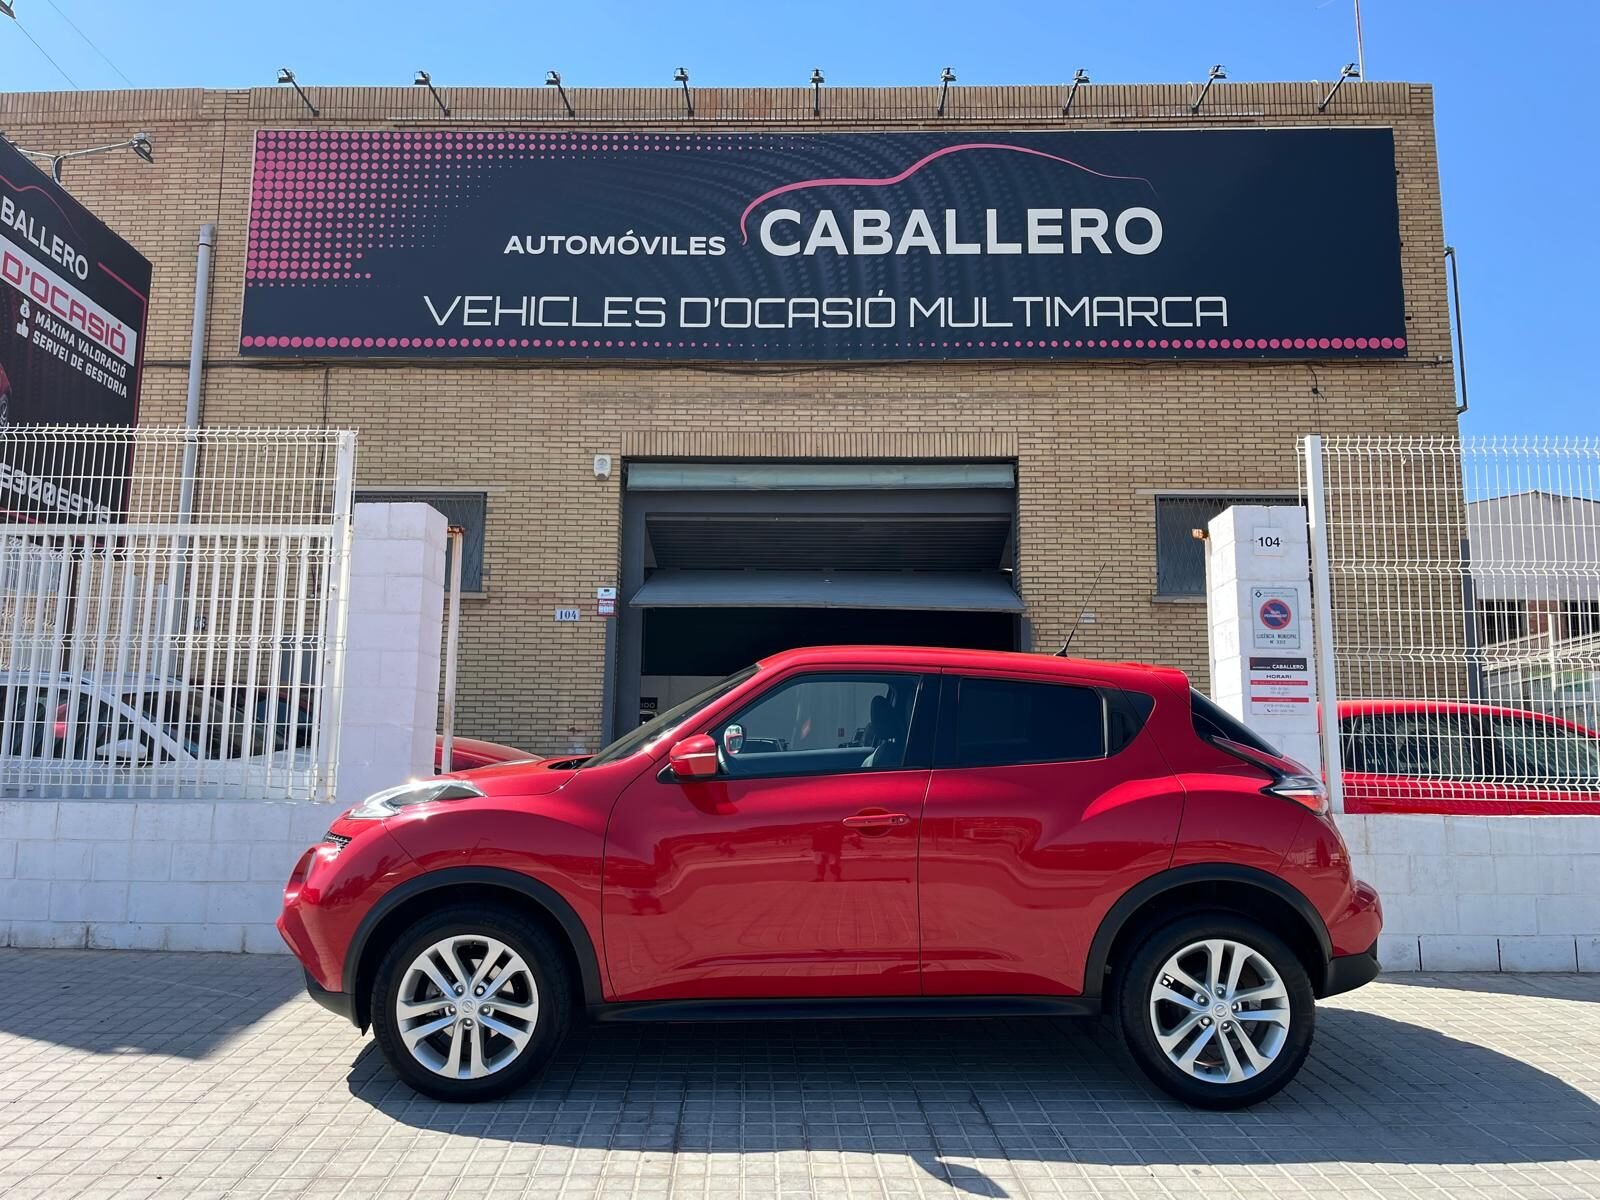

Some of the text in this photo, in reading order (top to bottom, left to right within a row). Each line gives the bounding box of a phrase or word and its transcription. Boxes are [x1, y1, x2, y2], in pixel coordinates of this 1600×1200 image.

[504, 207, 1163, 256] AUTOMÓVILES CABALLERO
[2, 250, 126, 356] D'OCASIÓ
[423, 289, 1228, 329] VEHICLES D'OCASIÓ MULTIMARCA
[32, 330, 127, 398] SERVEI DE GESTORIA
[35, 311, 127, 379] MÀXIMA VALORACIÓ
[1258, 536, 1281, 548] 104
[559, 610, 577, 620] 104
